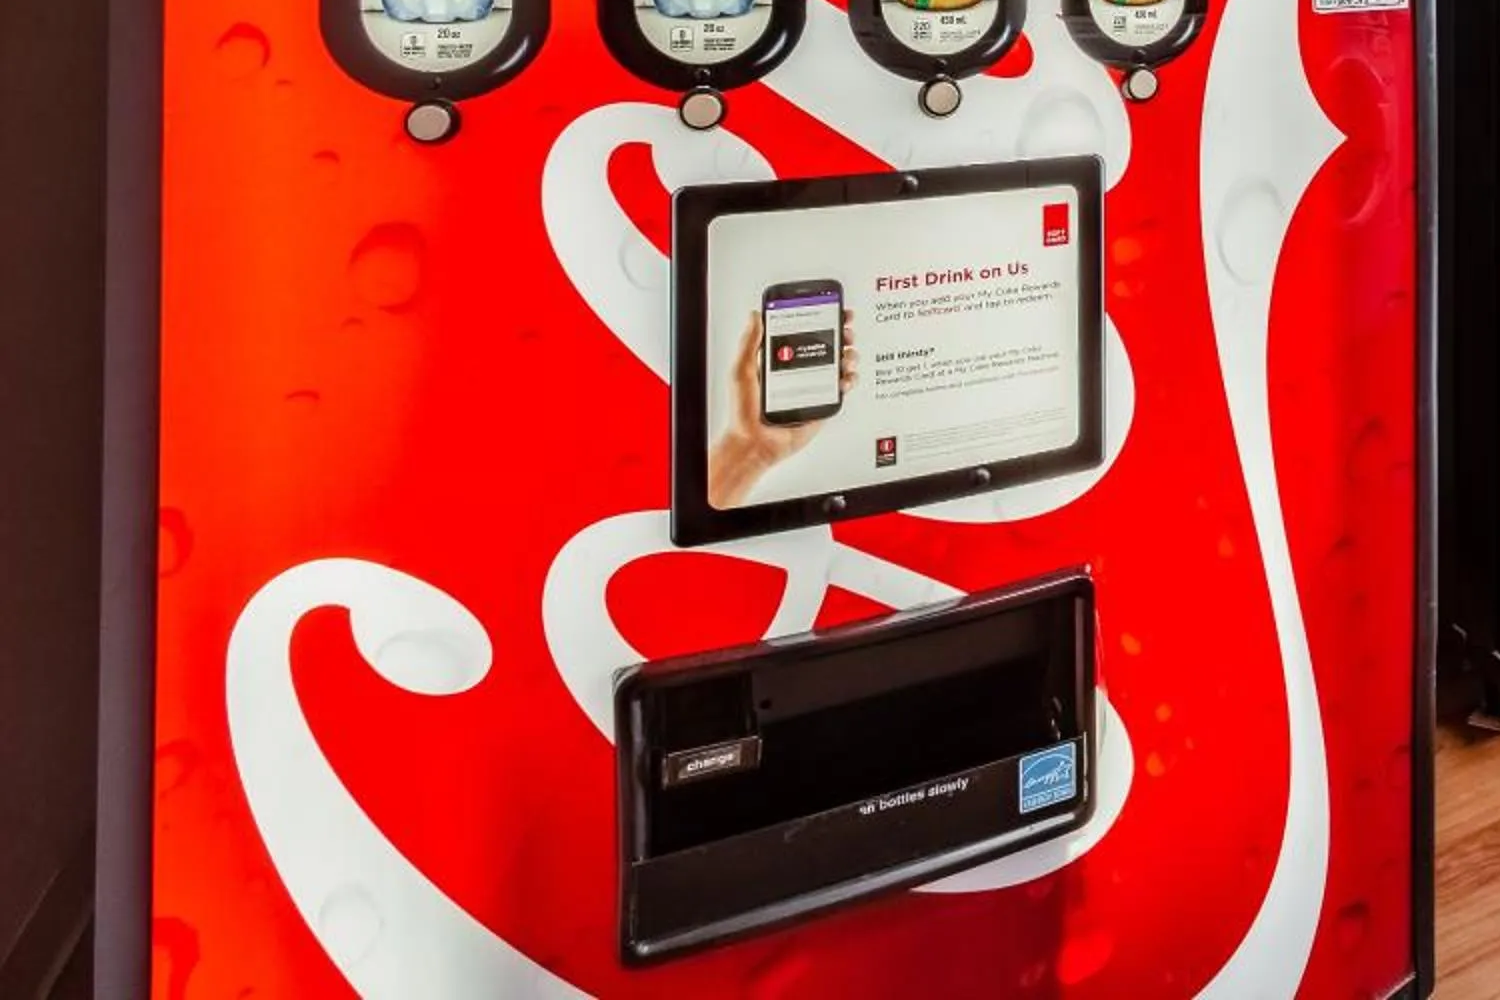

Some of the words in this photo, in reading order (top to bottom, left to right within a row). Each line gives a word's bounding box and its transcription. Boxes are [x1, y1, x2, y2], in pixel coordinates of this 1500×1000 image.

[876, 275, 919, 292] First
[924, 267, 974, 286] Drink
[980, 266, 1002, 279] on
[1007, 261, 1029, 275] Us
[879, 788, 925, 810] bottles
[928, 776, 970, 798] slowly
